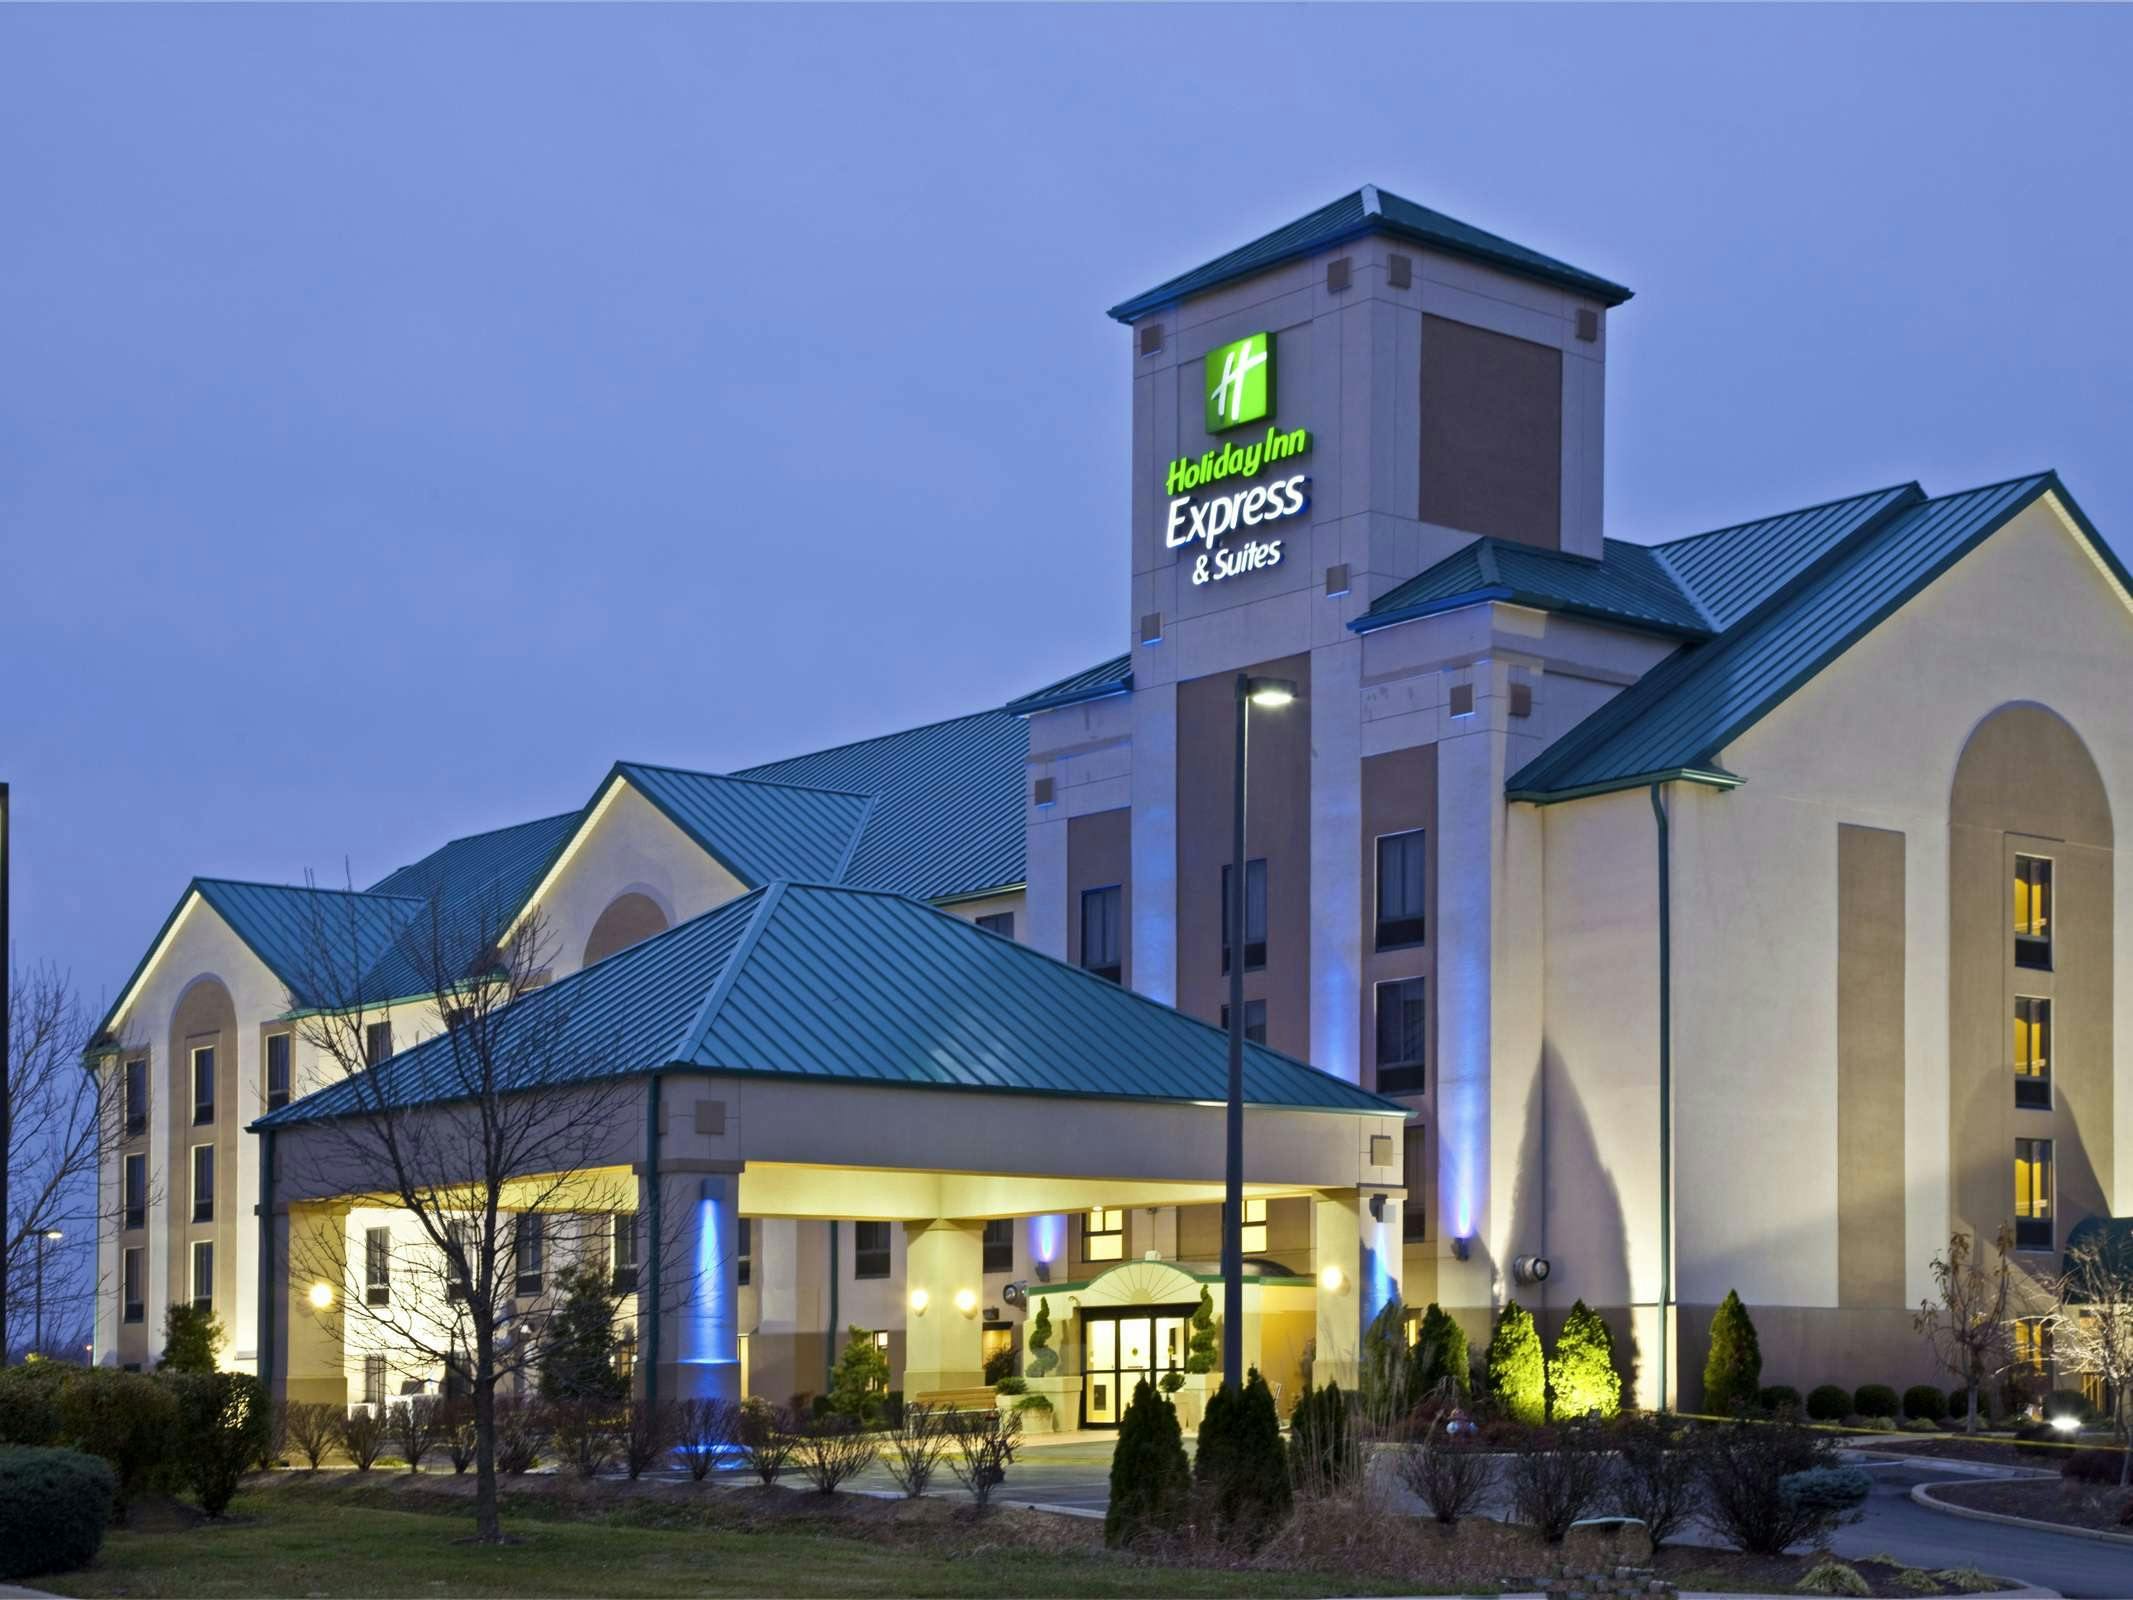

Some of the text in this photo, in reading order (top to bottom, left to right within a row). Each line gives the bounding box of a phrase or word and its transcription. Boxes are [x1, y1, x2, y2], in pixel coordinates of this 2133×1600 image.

[1166, 426, 1306, 495] Holiday Inn
[1166, 474, 1305, 549] Express
[1192, 540, 1281, 585] & Suites
